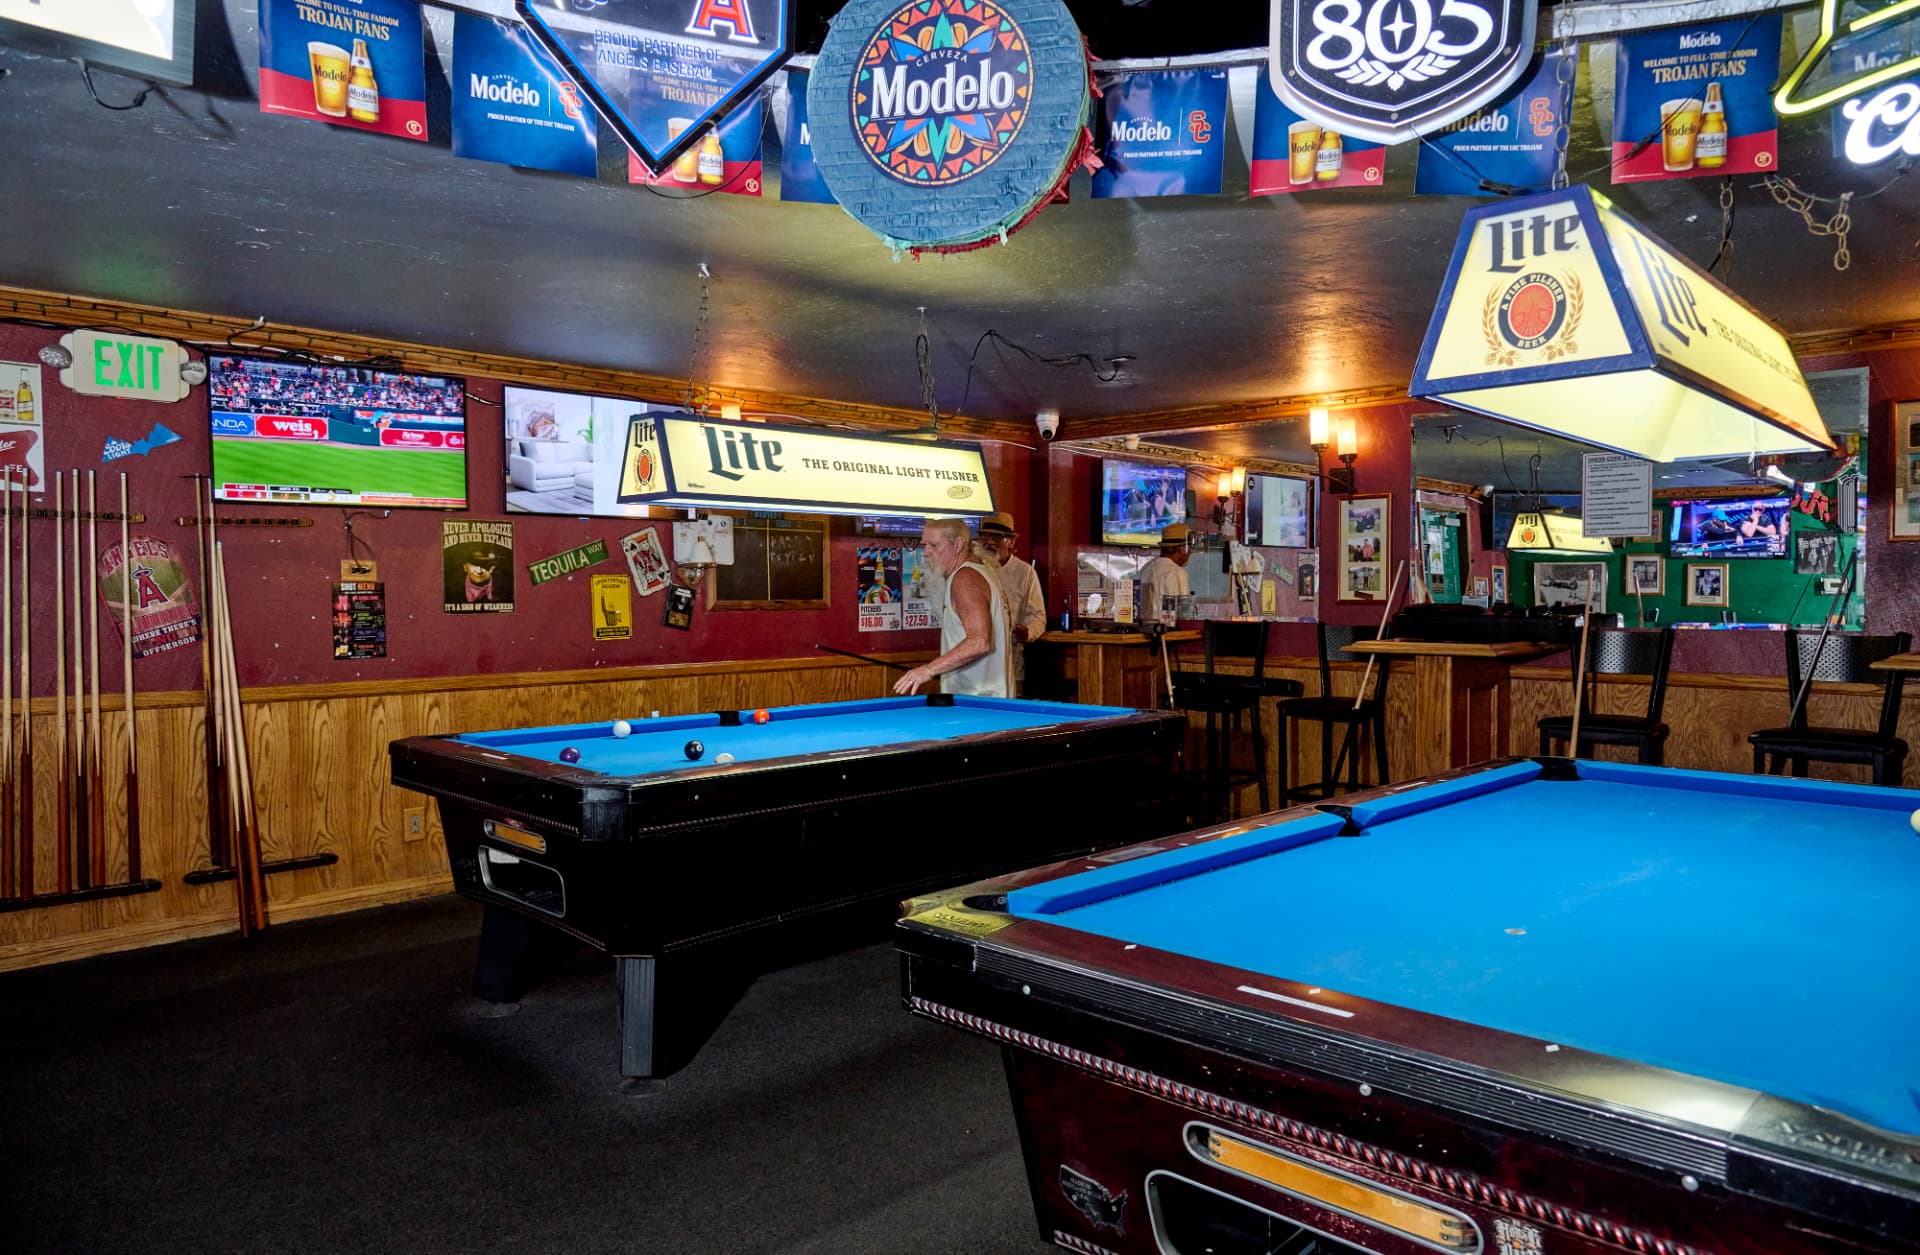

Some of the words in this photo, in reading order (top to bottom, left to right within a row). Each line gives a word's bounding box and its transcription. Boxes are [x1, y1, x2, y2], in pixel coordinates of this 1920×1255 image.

[296, 4, 353, 32] TROJAN
[355, 19, 390, 40] FANS
[333, 4, 369, 20] FULL-TIME
[371, 13, 399, 27] FANDOM
[594, 30, 639, 50] PROUD
[643, 37, 701, 60] PARTNER
[705, 48, 721, 63] OF
[1306, 0, 1494, 70] 805
[1680, 33, 1721, 50] Modelo
[597, 49, 649, 71] ANGELS
[916, 50, 968, 68] CERVEZA
[1643, 57, 1678, 69] WELCOME
[1689, 52, 1727, 62] FULL-TIME
[315, 63, 347, 82] Modelo
[1652, 63, 1708, 84] TROJAN
[1711, 60, 1746, 77] FANS
[470, 73, 540, 107] Modelo
[660, 85, 705, 105] TROJAN
[871, 58, 1015, 120] Modelo
[1111, 121, 1171, 141] Modelo
[1486, 215, 1580, 273] Lite
[1530, 272, 1564, 302] PILSNER
[1628, 231, 1708, 347] Lite
[1517, 336, 1546, 348] BEER
[94, 340, 164, 390] EXIT
[272, 420, 312, 432] weis
[634, 422, 656, 448] Lite
[704, 426, 784, 482] Lite
[802, 458, 829, 470] THE
[833, 461, 893, 475] ORIGINAL
[896, 466, 931, 479] LIGHT
[935, 470, 980, 483] PILSNER
[443, 522, 470, 535] NEVER
[471, 522, 513, 537] APOLOGIZE
[444, 535, 458, 549] AND
[459, 533, 482, 544] NEVER
[483, 534, 513, 550] EXPLAIN
[530, 550, 590, 583] TEQUILA
[586, 542, 603, 554] WAY
[132, 629, 161, 643] WHERE
[162, 619, 198, 634] THERE'S
[861, 616, 883, 627] $16.00
[905, 615, 928, 627] $27.50
